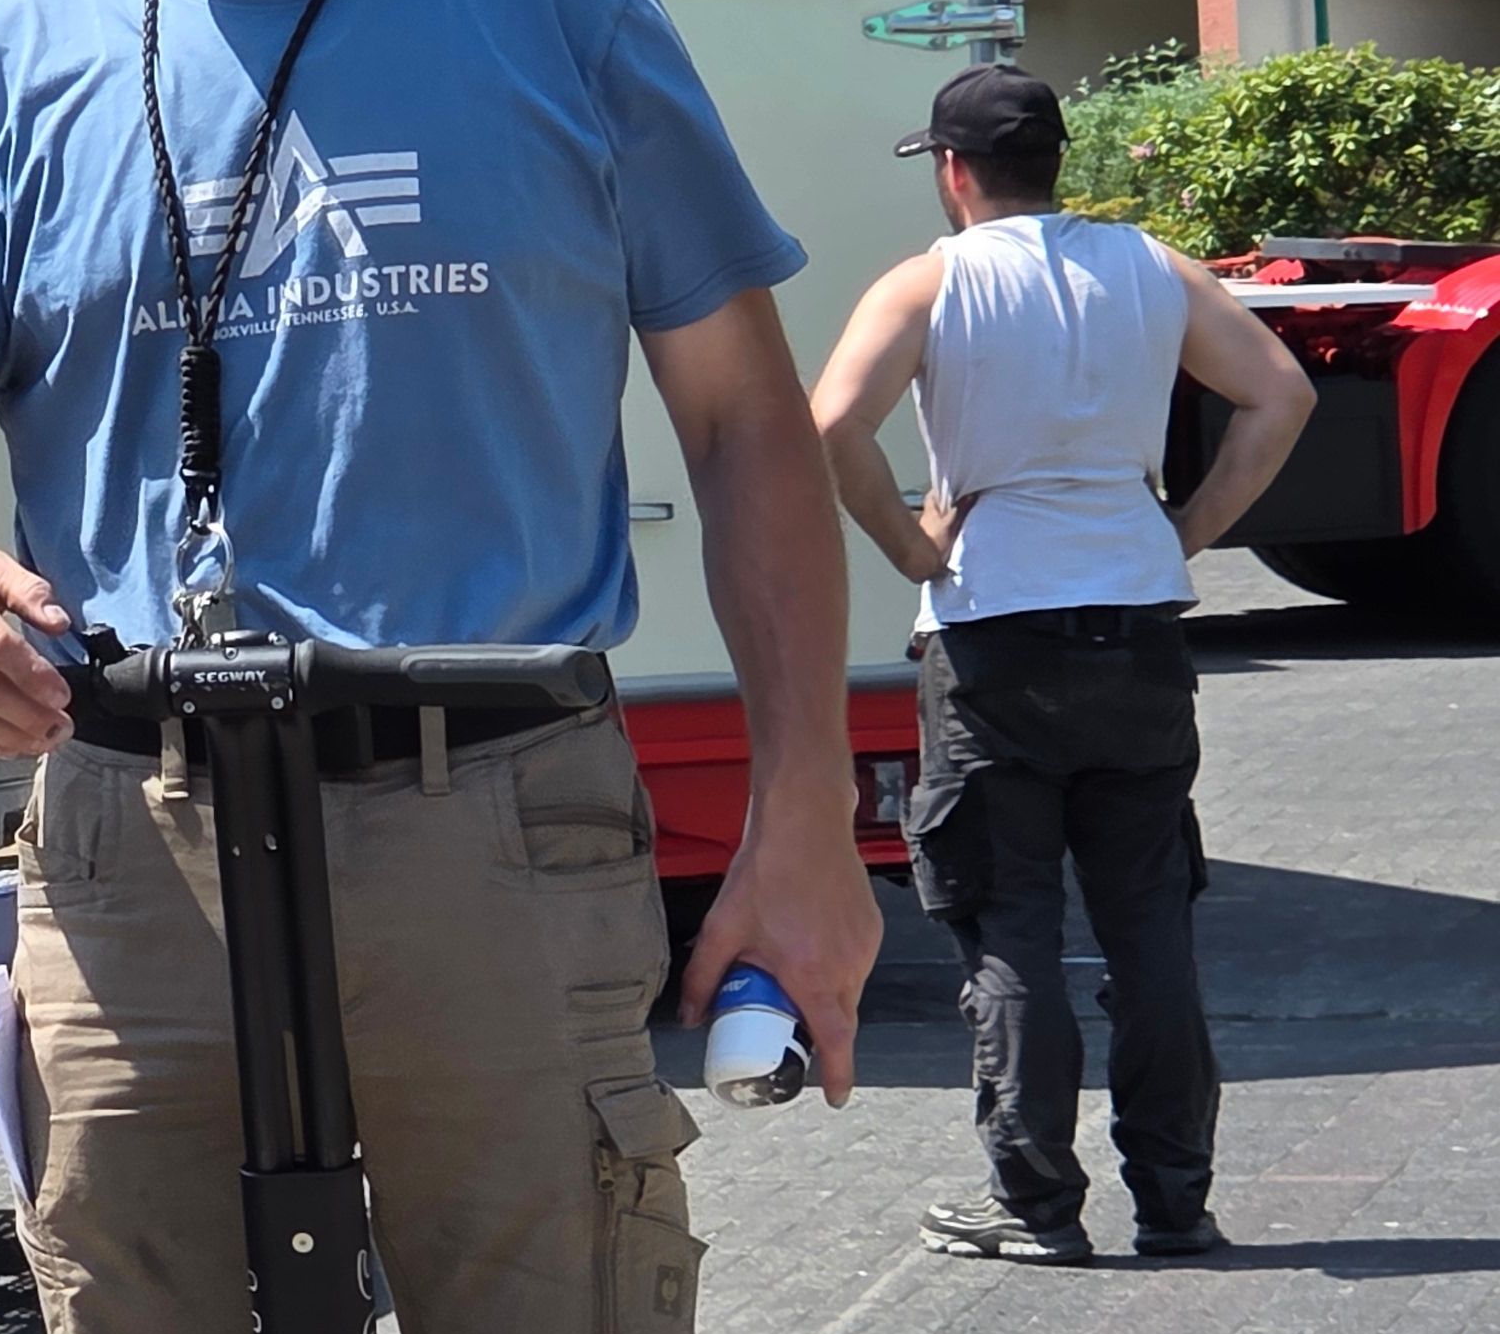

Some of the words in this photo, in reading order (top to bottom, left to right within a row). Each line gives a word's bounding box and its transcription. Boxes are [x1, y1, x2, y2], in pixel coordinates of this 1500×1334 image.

[267, 262, 490, 315] INDUSTRIES
[213, 318, 277, 341] OXVILL
[193, 670, 266, 684] SEGWAY
